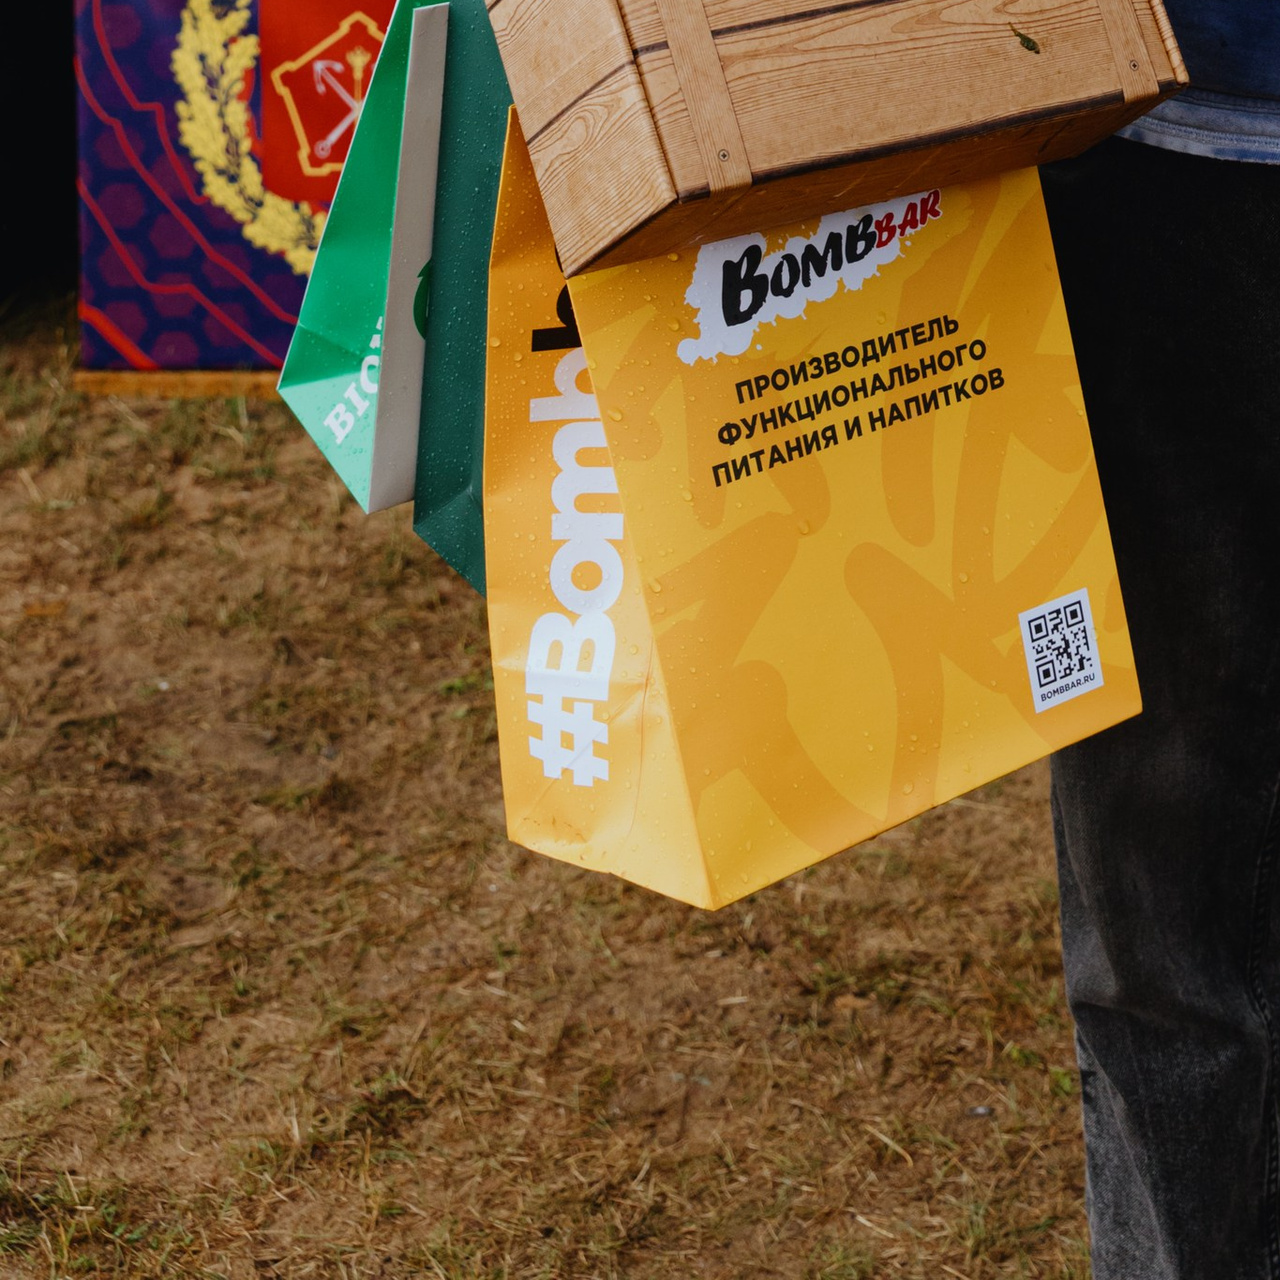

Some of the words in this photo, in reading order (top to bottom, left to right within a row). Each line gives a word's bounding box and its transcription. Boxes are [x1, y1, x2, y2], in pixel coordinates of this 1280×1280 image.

[717, 339, 987, 446] ФУНКЦИОНАЛЬНОГО
[735, 314, 960, 405] ПРОИЗВОДИТЕЛЬ
[711, 424, 839, 488] ПИТАНИЯ
[844, 416, 863, 441] И
[868, 367, 1006, 432] НАПИТКОВ
[1040, 672, 1096, 703] BOMBBAR.RU
